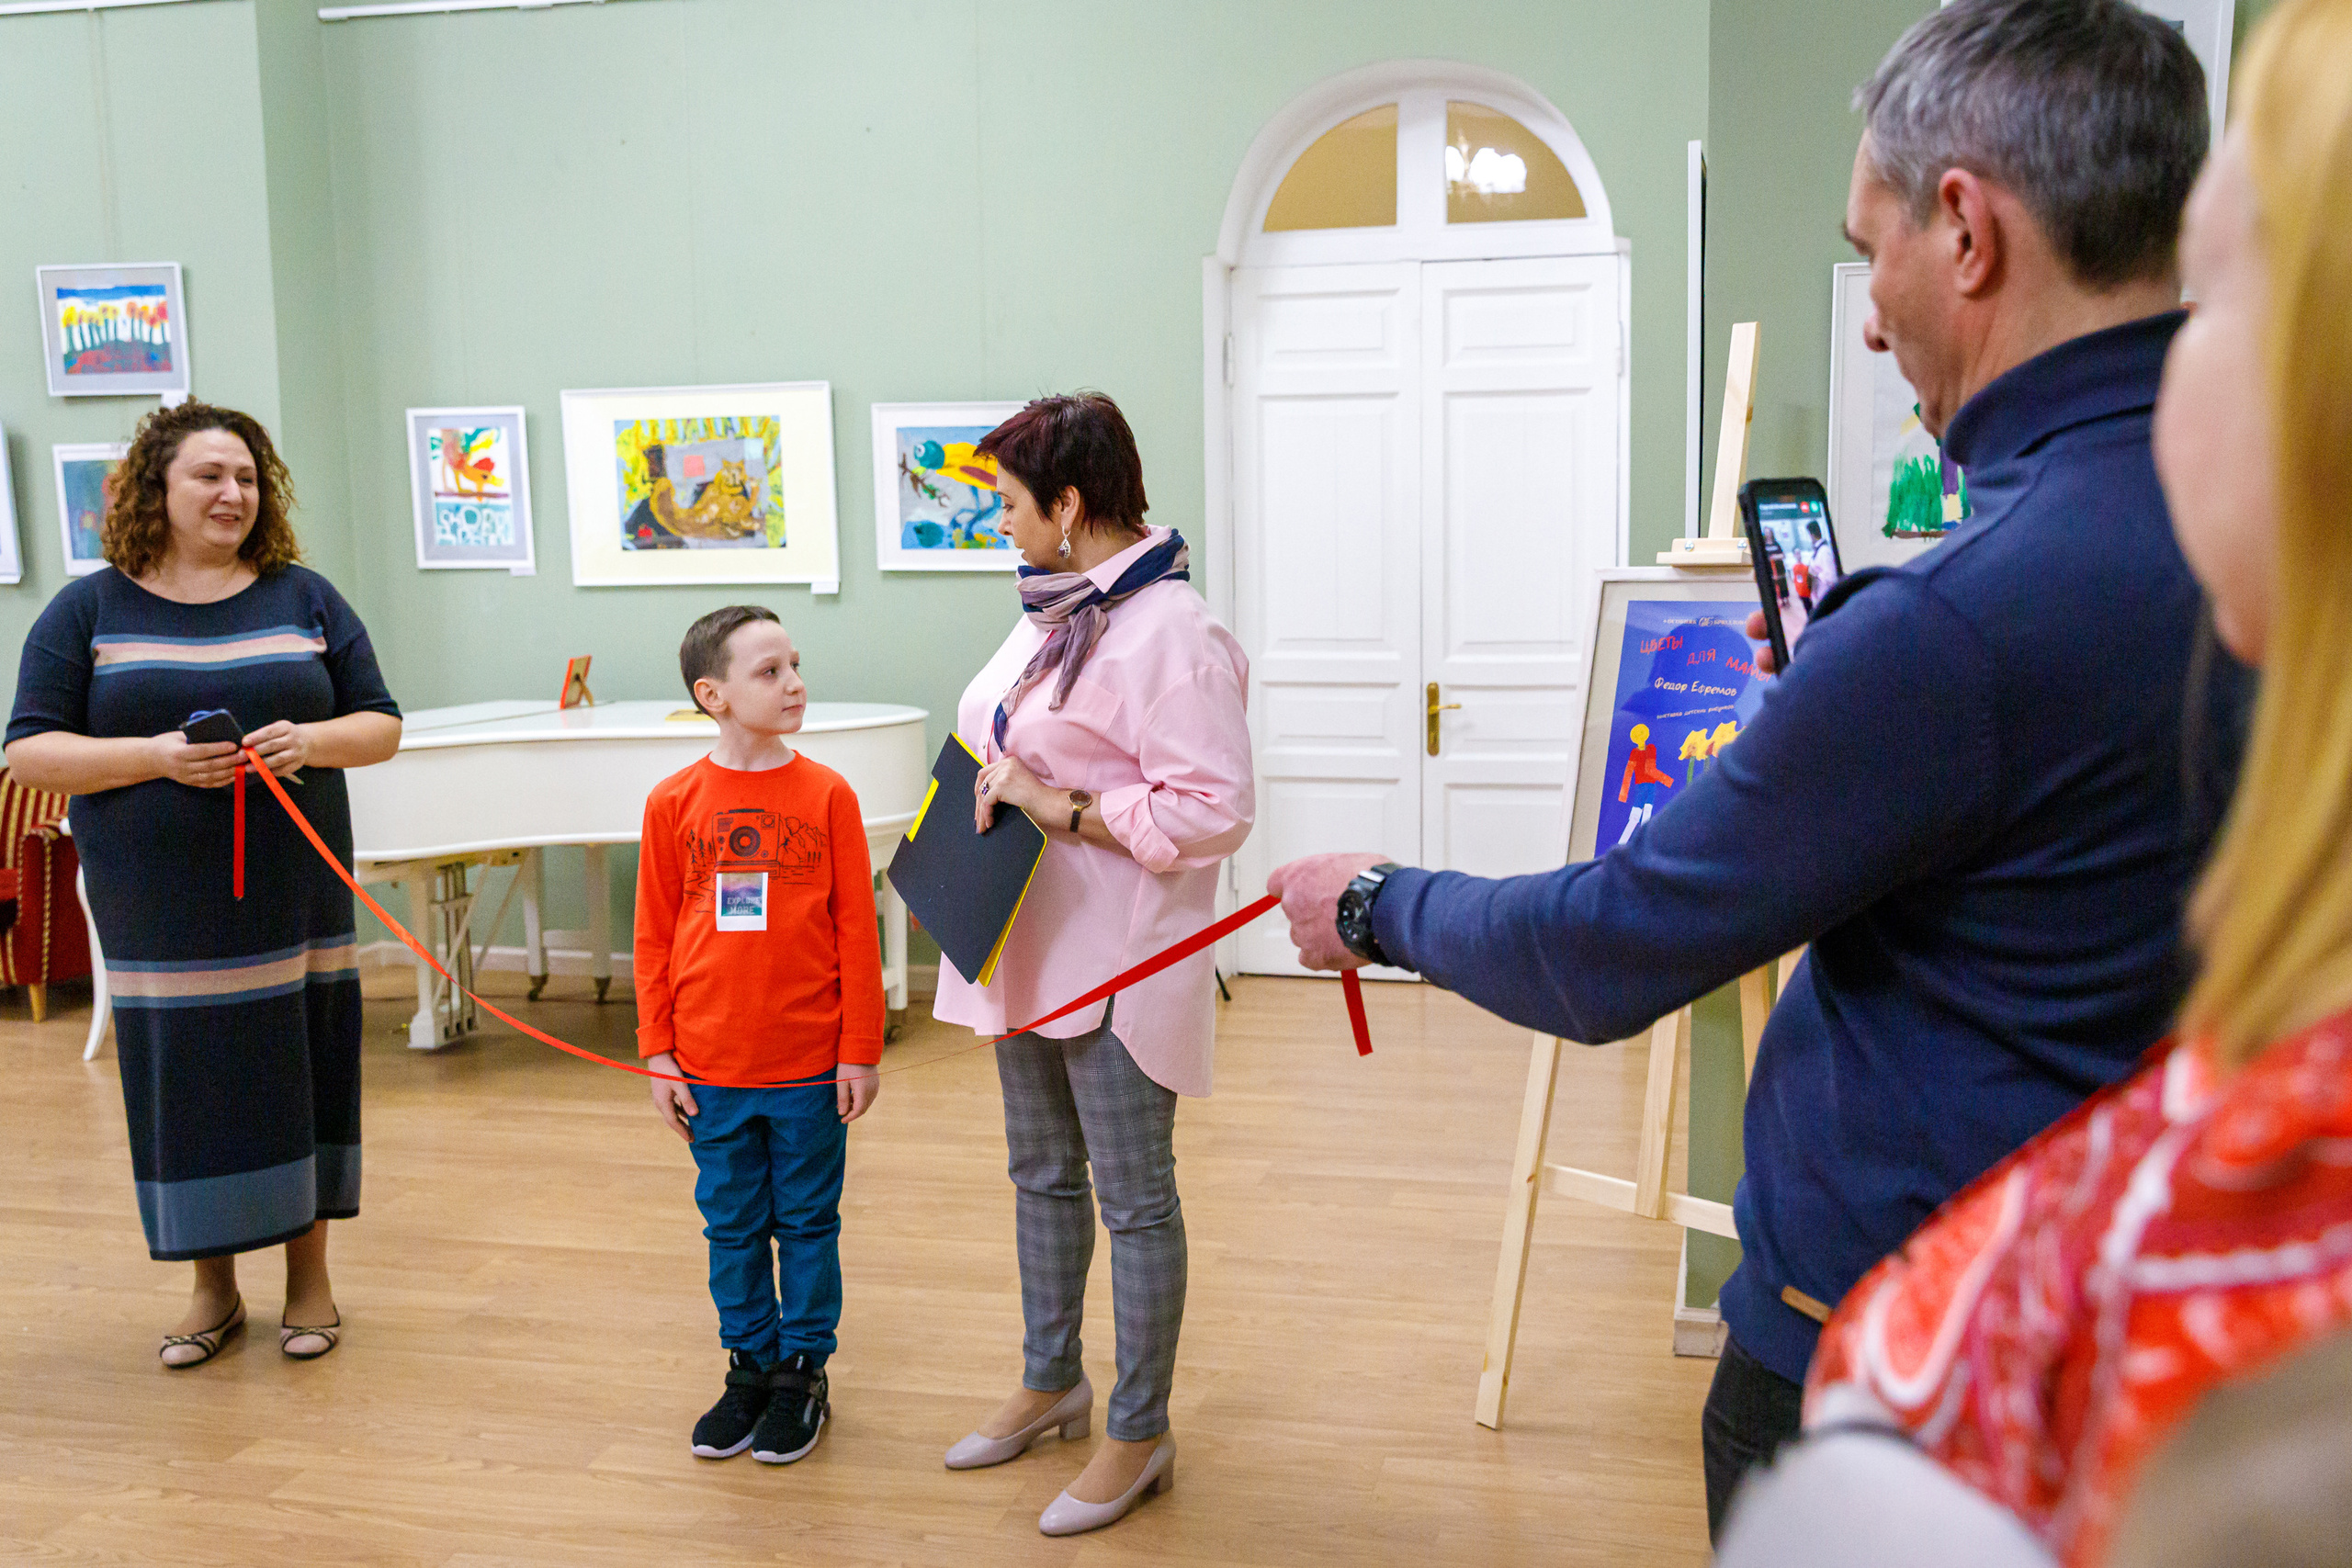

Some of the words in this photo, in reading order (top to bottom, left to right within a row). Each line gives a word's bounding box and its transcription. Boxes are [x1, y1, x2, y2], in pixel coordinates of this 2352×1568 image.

[1640, 636, 1683, 654] ЦВЕТЫ
[1687, 649, 1715, 666] ДЛЯ
[1725, 656, 1771, 682] МАМЫ
[1654, 677, 1687, 693] Федор
[1691, 681, 1736, 696] Ефремов
[727, 897, 761, 905] EXPLORE
[729, 906, 754, 914] MORE
